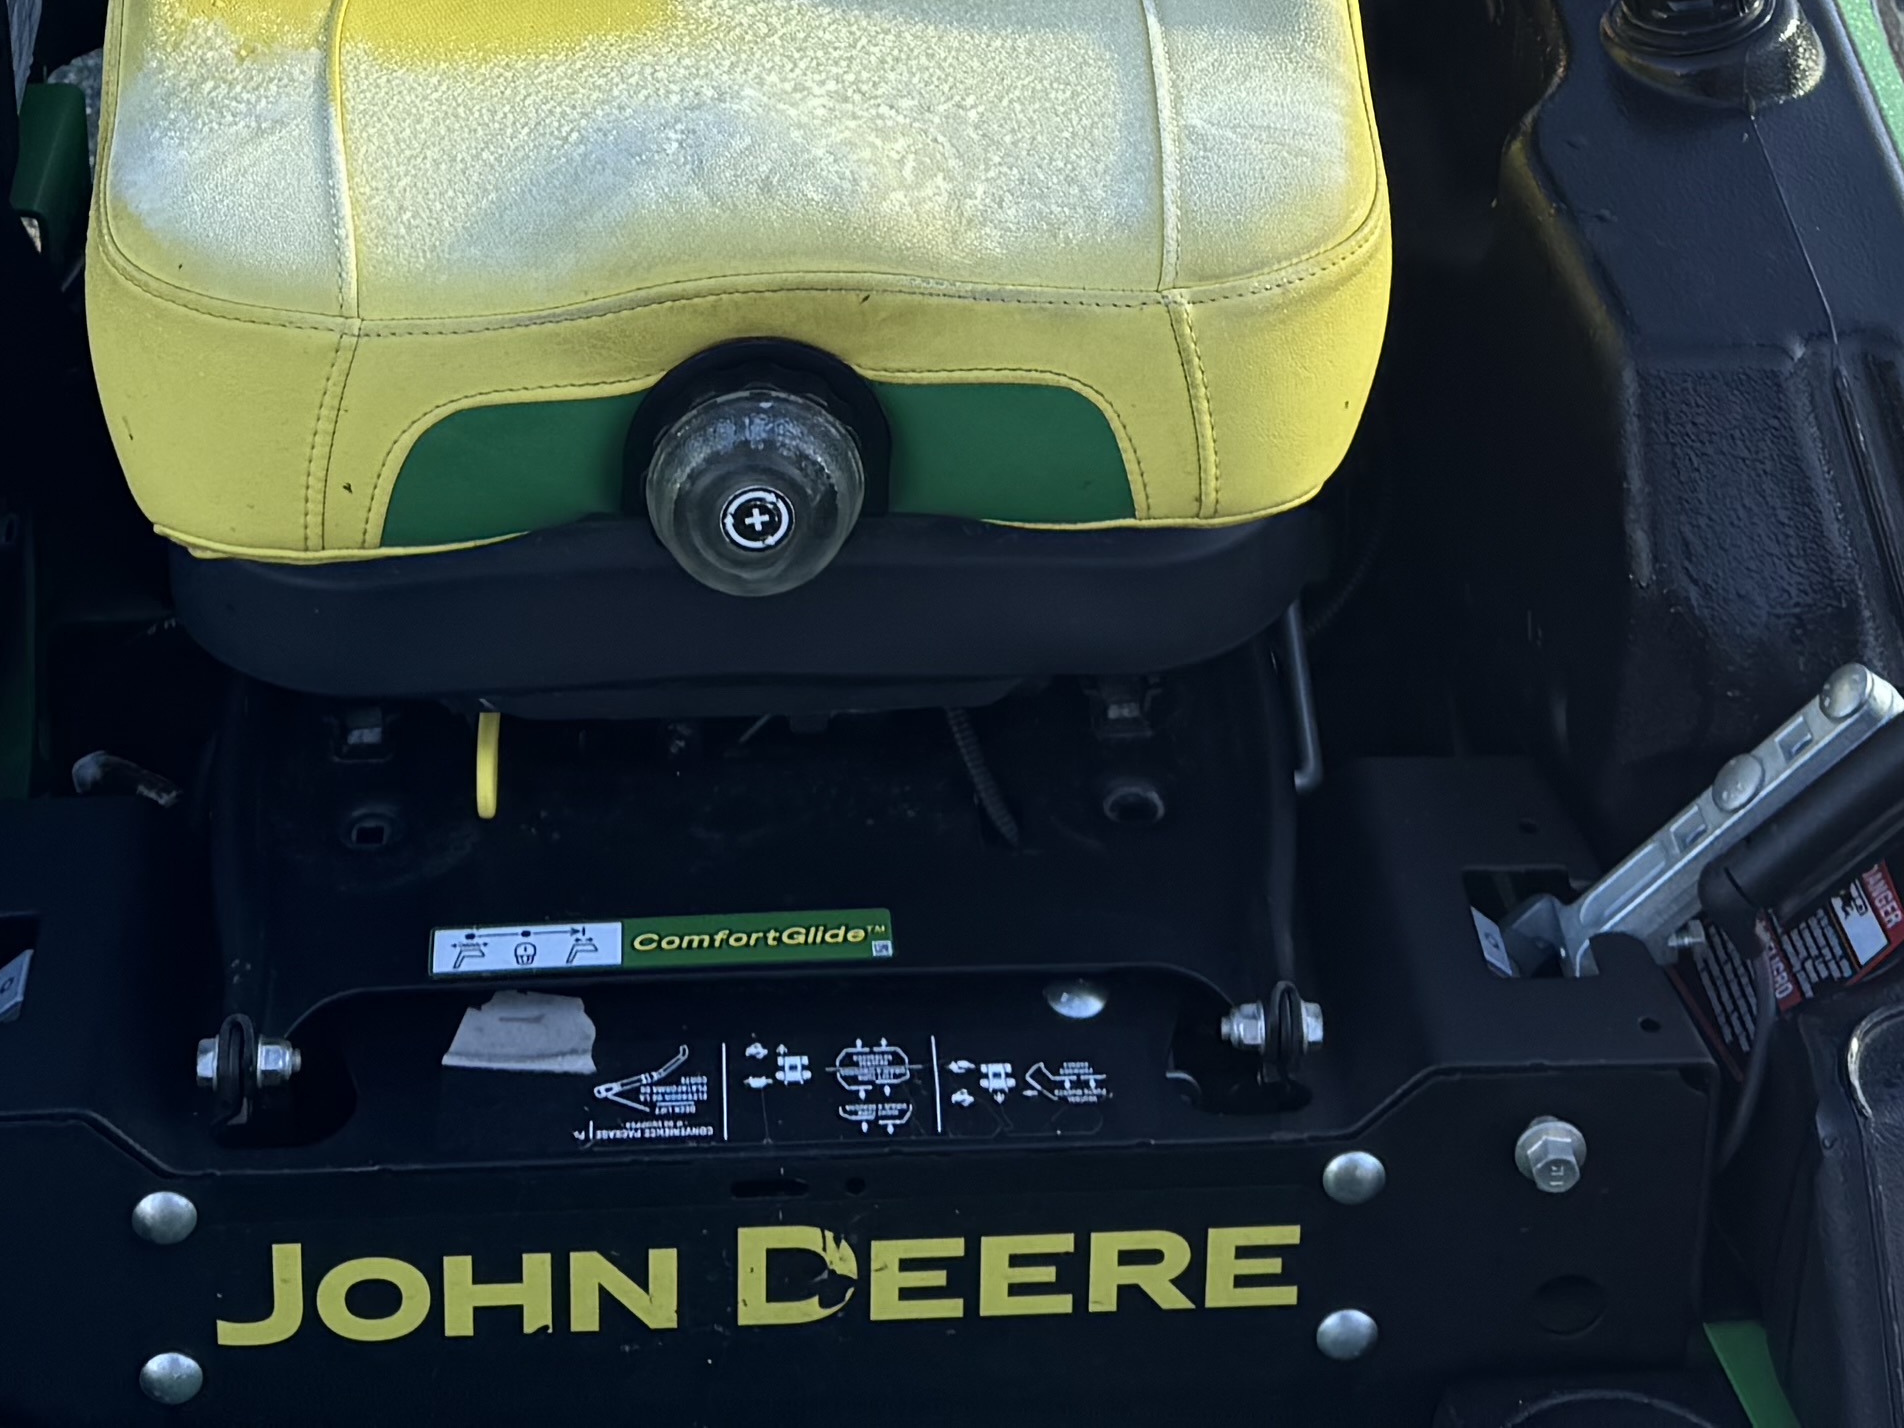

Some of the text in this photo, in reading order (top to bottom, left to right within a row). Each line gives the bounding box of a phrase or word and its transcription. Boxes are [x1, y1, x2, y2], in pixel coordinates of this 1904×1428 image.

[644, 1126, 714, 1138] CONVENIENCE
[216, 1224, 1301, 1346] JOHN DEERE
